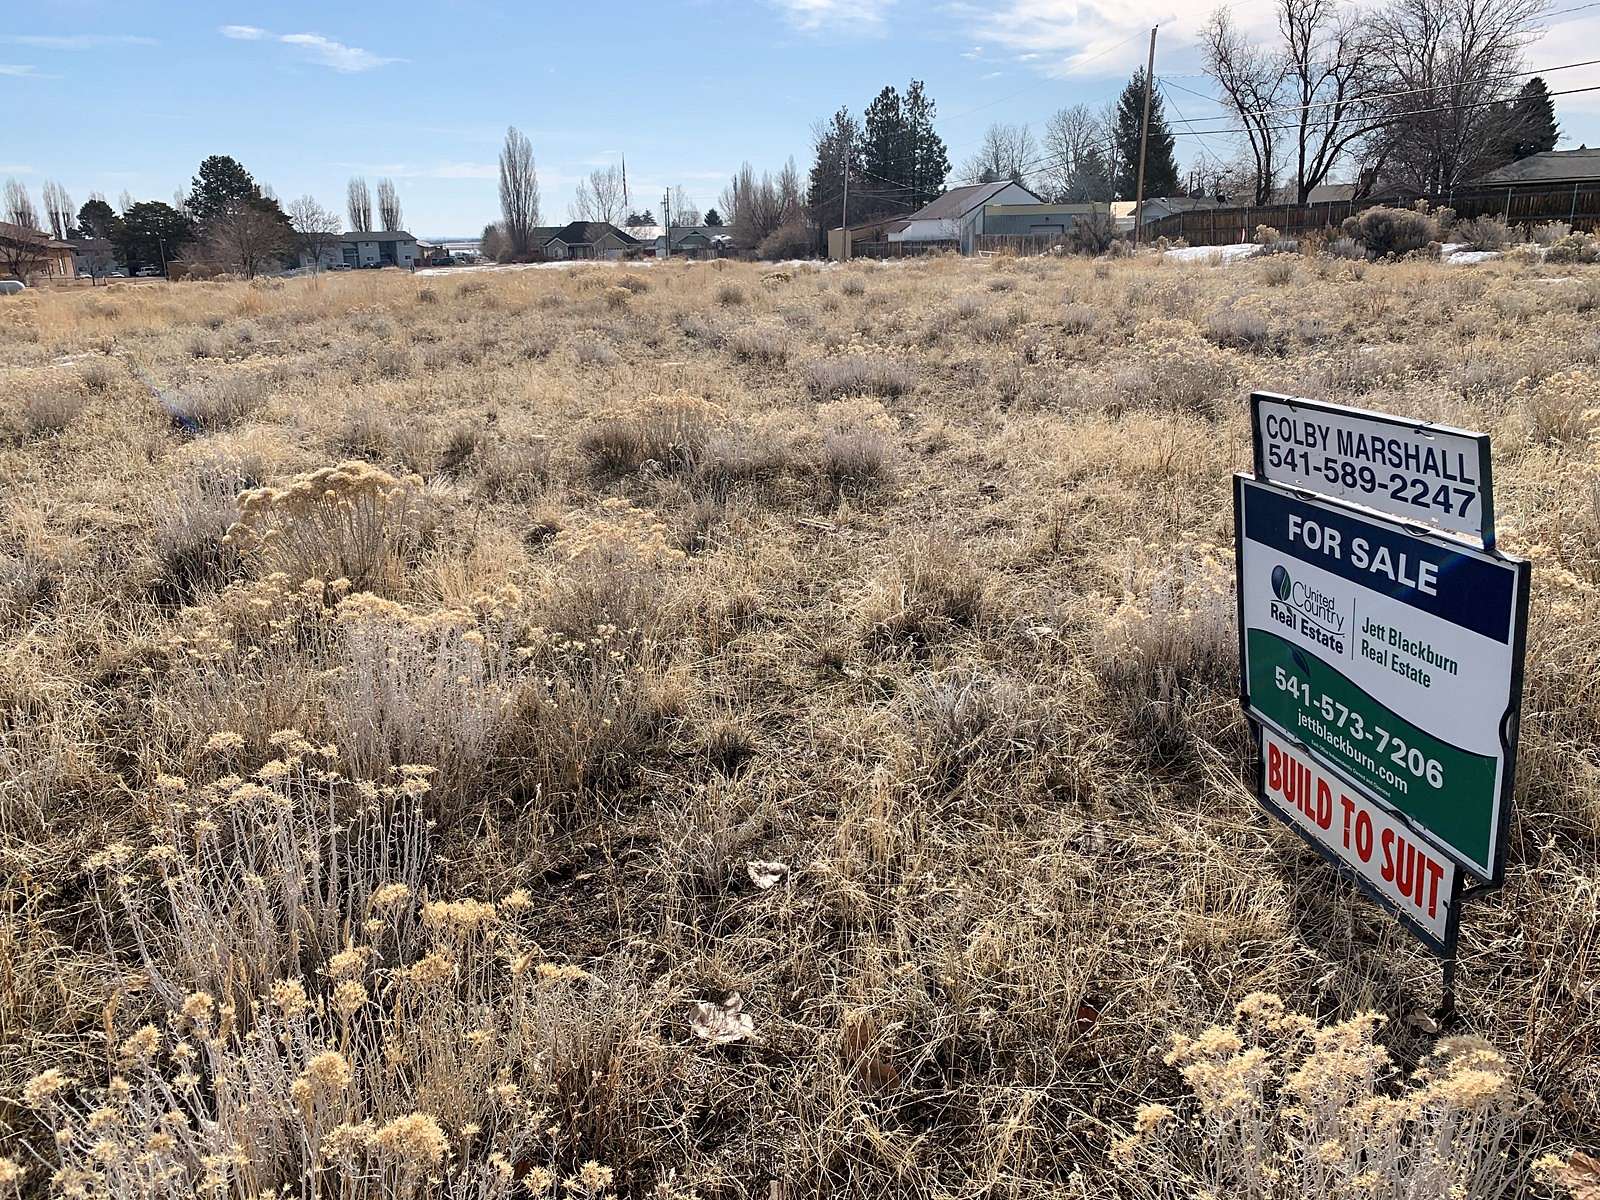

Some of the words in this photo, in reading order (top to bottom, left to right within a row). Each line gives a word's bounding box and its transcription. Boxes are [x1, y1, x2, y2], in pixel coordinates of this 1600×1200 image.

[1266, 414, 1330, 451] COLBY
[1338, 429, 1475, 486] MARSHALL
[1268, 443, 1476, 518] 541-589-2247
[1288, 514, 1342, 559] FOR
[1351, 537, 1439, 596] SALE
[1270, 602, 1296, 630] Real
[1300, 618, 1344, 654] Estate
[1292, 581, 1345, 632] Country
[1304, 584, 1335, 610] United
[1361, 617, 1386, 642] Jett
[1389, 627, 1458, 675] Blackburn
[1361, 639, 1387, 667] Real
[1391, 654, 1431, 688] Estate
[1274, 665, 1444, 789] 541-573-7206
[1298, 708, 1408, 794] jettblackburn.com
[1268, 741, 1333, 830] BUILD
[1340, 794, 1374, 863] TO
[1380, 828, 1444, 920] SUIT
